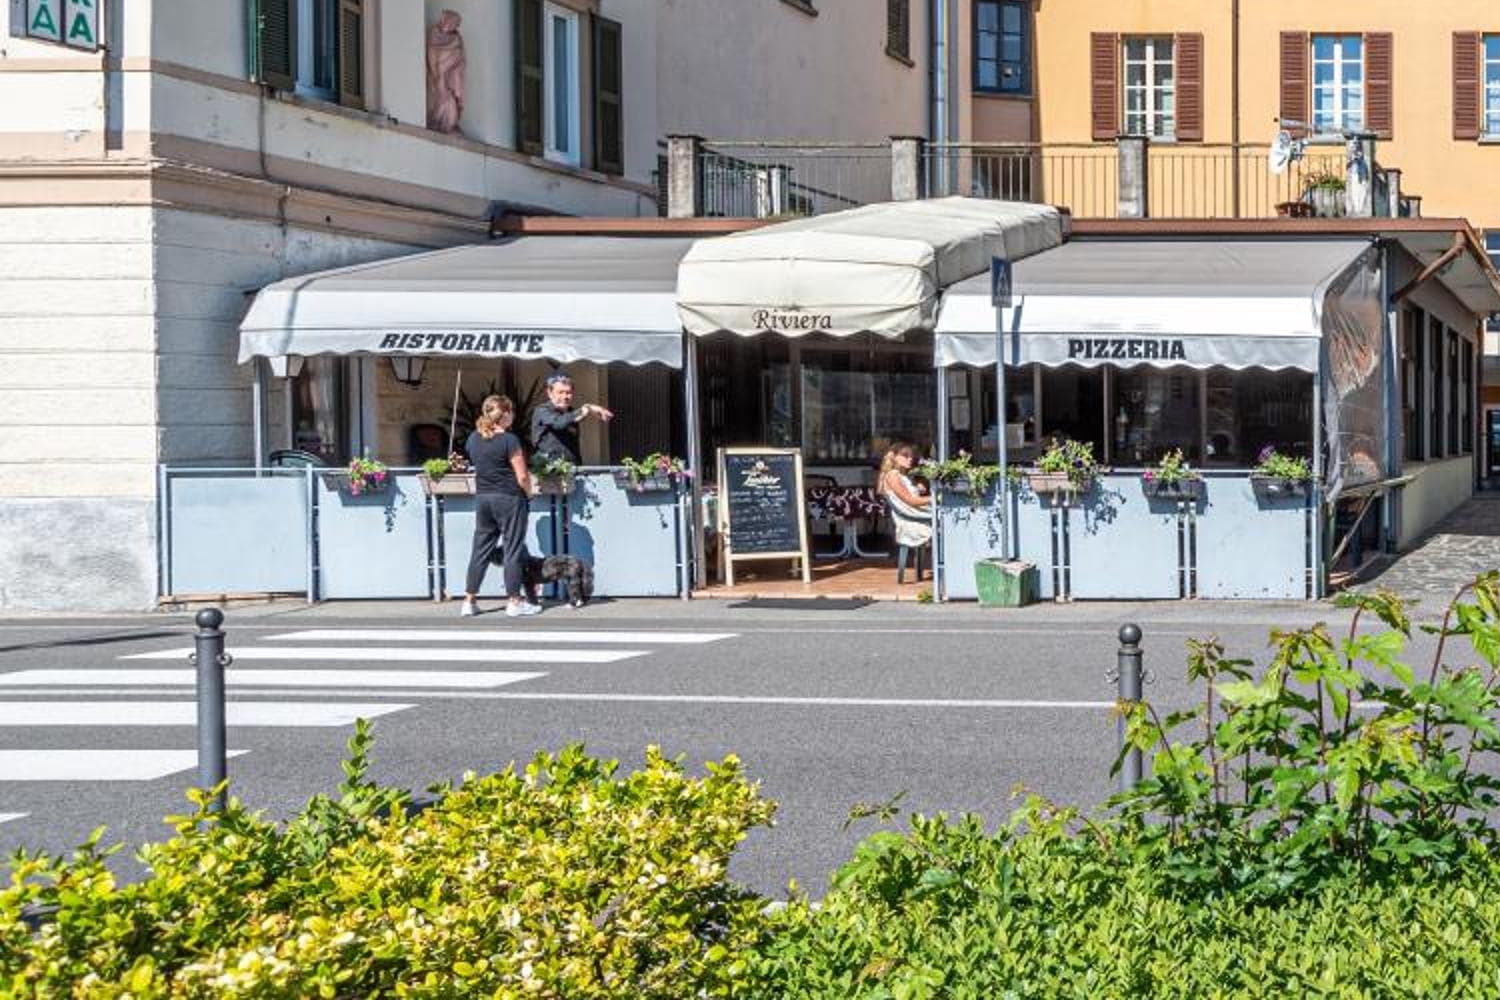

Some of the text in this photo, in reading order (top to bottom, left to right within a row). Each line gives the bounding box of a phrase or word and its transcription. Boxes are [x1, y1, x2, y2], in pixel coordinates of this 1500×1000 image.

[752, 309, 832, 329] Riviera
[379, 333, 545, 353] RISTORANTE
[1068, 338, 1187, 360] PIZZERIA
